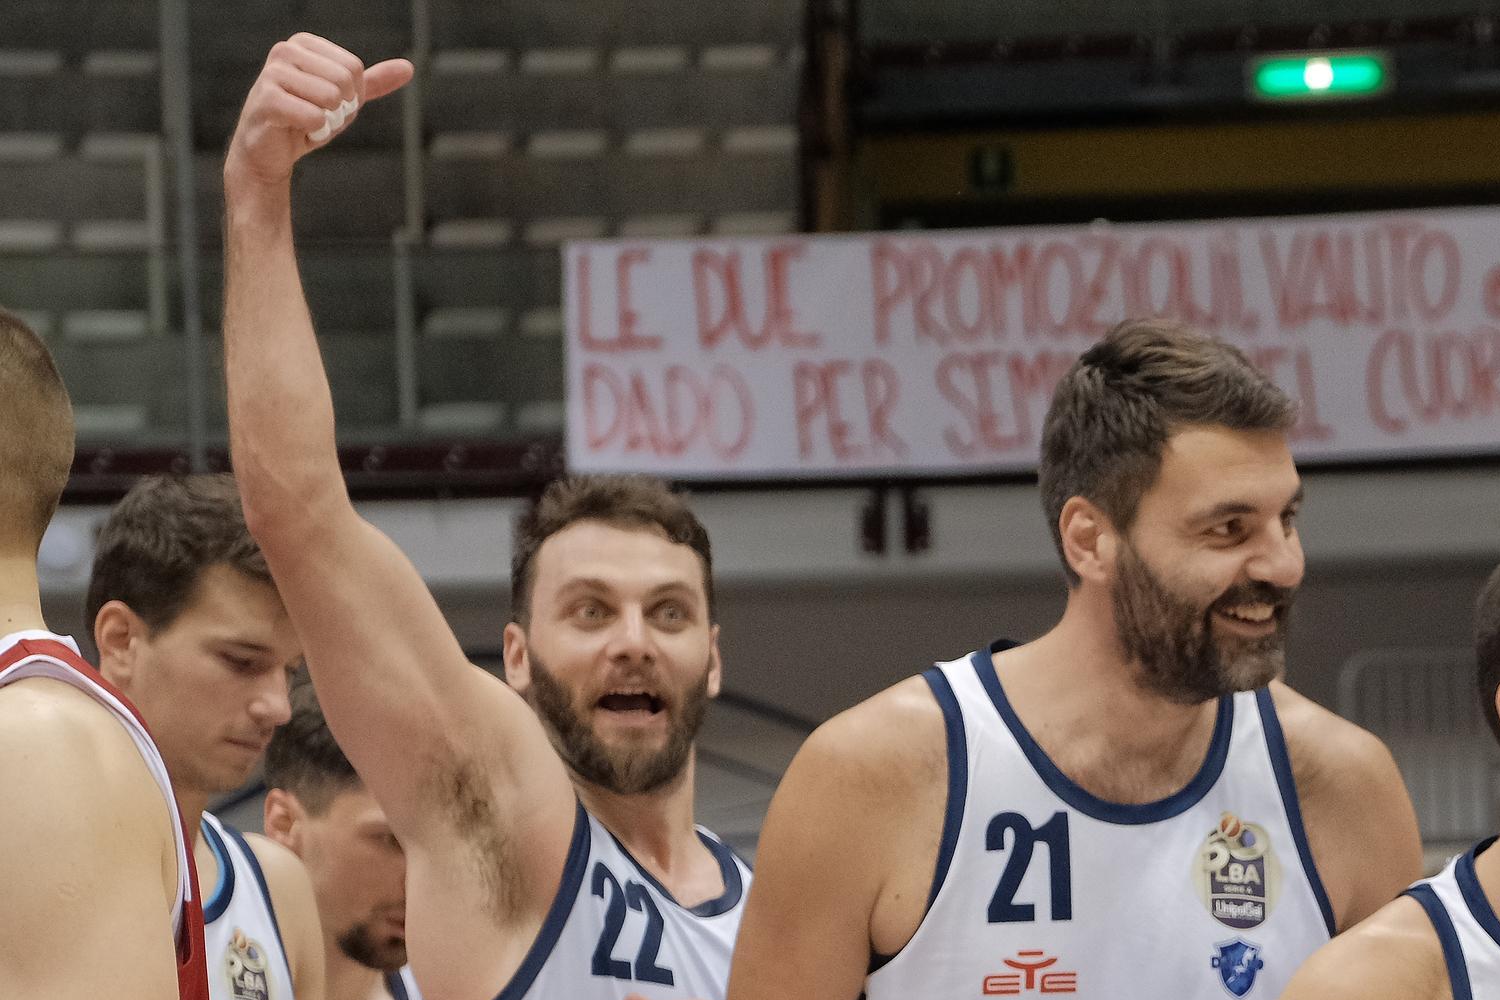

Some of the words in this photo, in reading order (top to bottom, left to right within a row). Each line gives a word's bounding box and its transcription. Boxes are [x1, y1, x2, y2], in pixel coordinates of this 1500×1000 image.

[576, 247, 662, 352] LE
[692, 241, 822, 351] DUE
[581, 362, 756, 462] DADO
[792, 356, 906, 462] PER
[984, 810, 1073, 924] 21
[591, 861, 675, 987] 22
